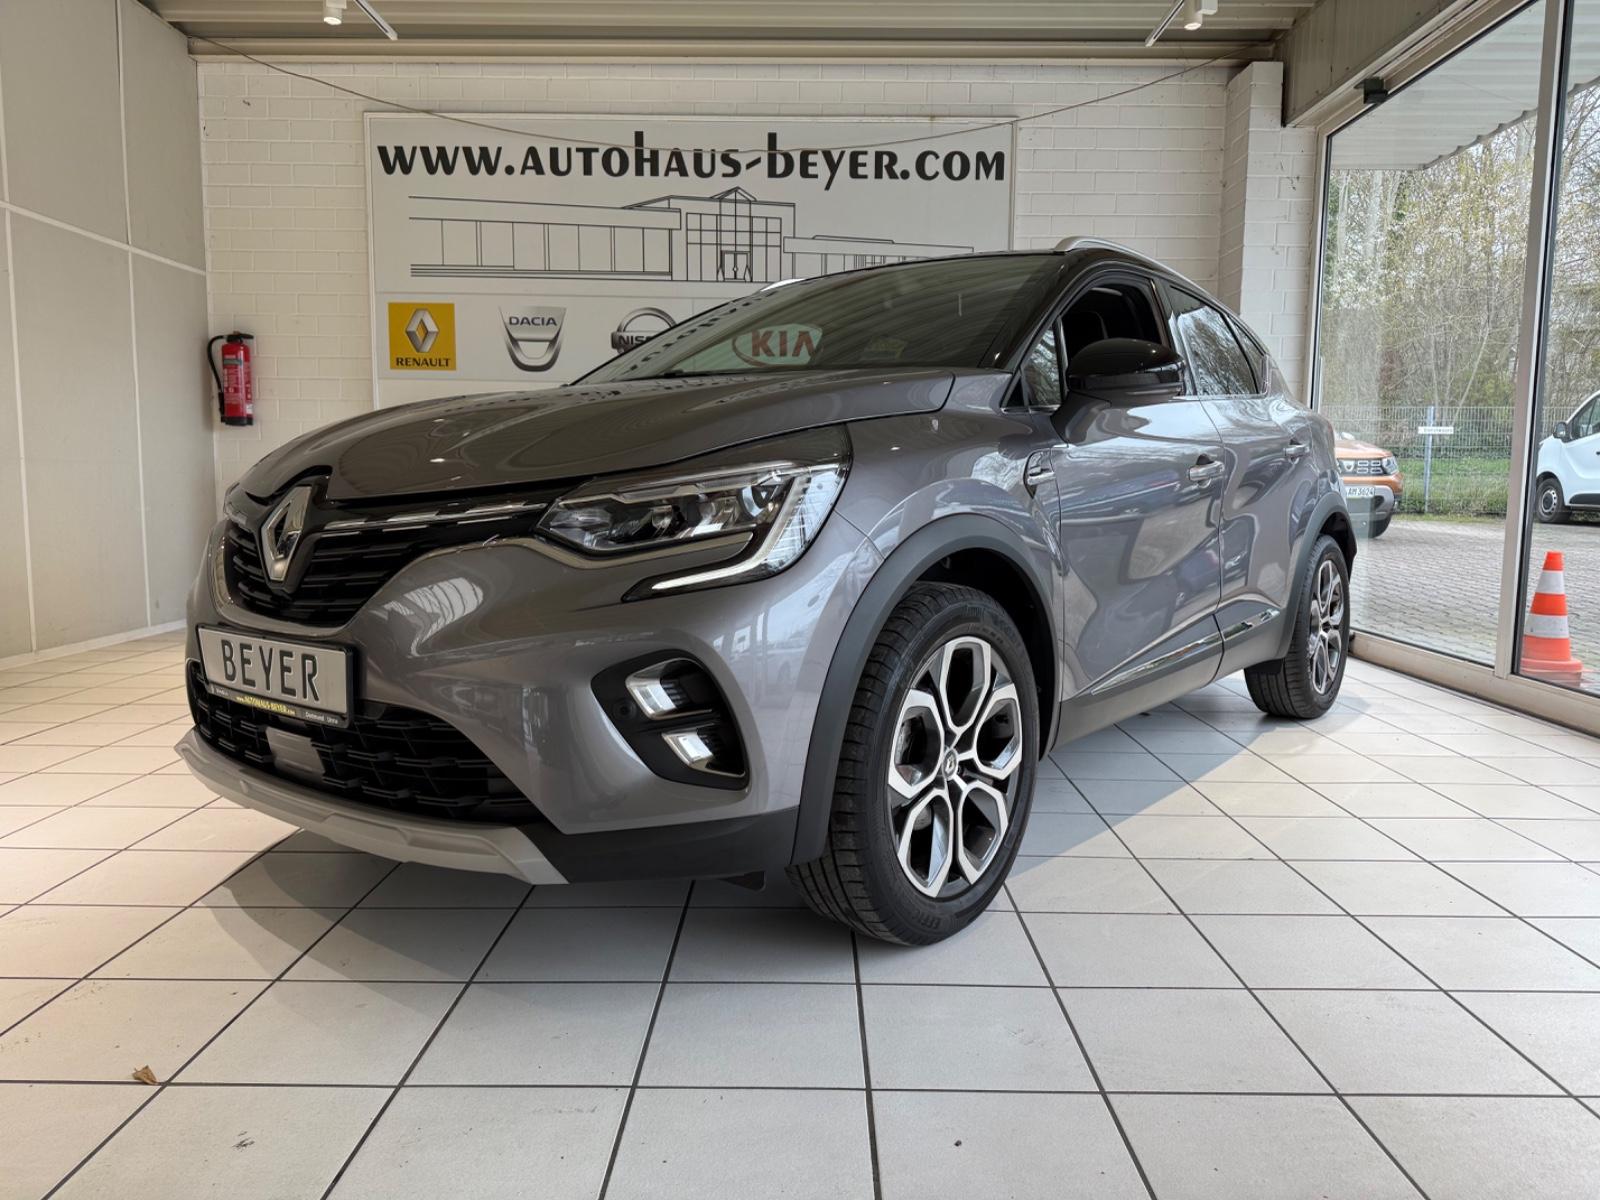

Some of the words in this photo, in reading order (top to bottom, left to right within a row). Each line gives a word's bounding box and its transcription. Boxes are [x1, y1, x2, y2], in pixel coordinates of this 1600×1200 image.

[509, 316, 557, 326] DACIA
[751, 330, 816, 358] KIA
[395, 357, 450, 367] RENAULT
[221, 639, 319, 701] BEYER
